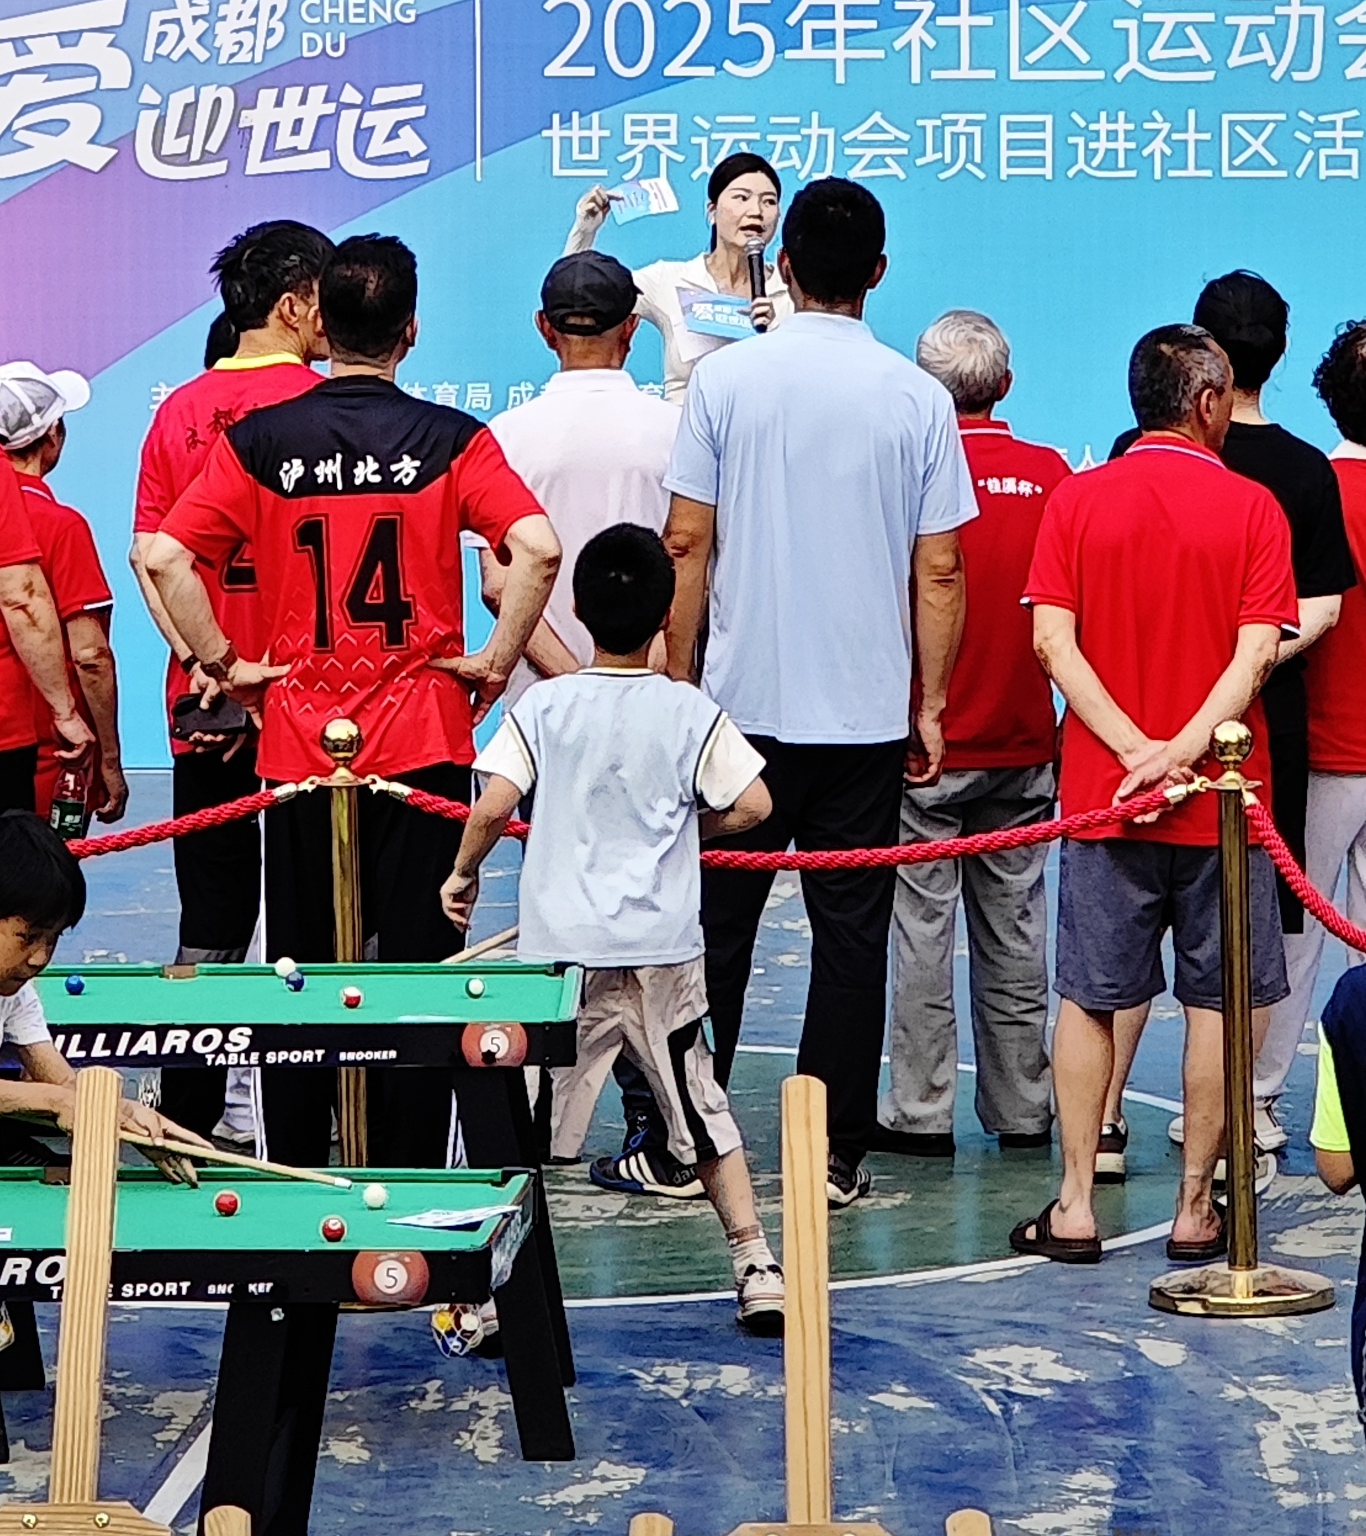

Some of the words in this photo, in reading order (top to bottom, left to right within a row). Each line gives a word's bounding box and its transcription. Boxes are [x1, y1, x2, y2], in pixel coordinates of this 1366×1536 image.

[301, 32, 348, 59] DU
[134, 82, 431, 181] 迎世运
[278, 453, 421, 493] 泸州北方
[291, 511, 418, 655] 14
[204, 1052, 260, 1066] TABLE
[265, 1048, 326, 1064] SPORT
[121, 1281, 191, 1297] SPORT
